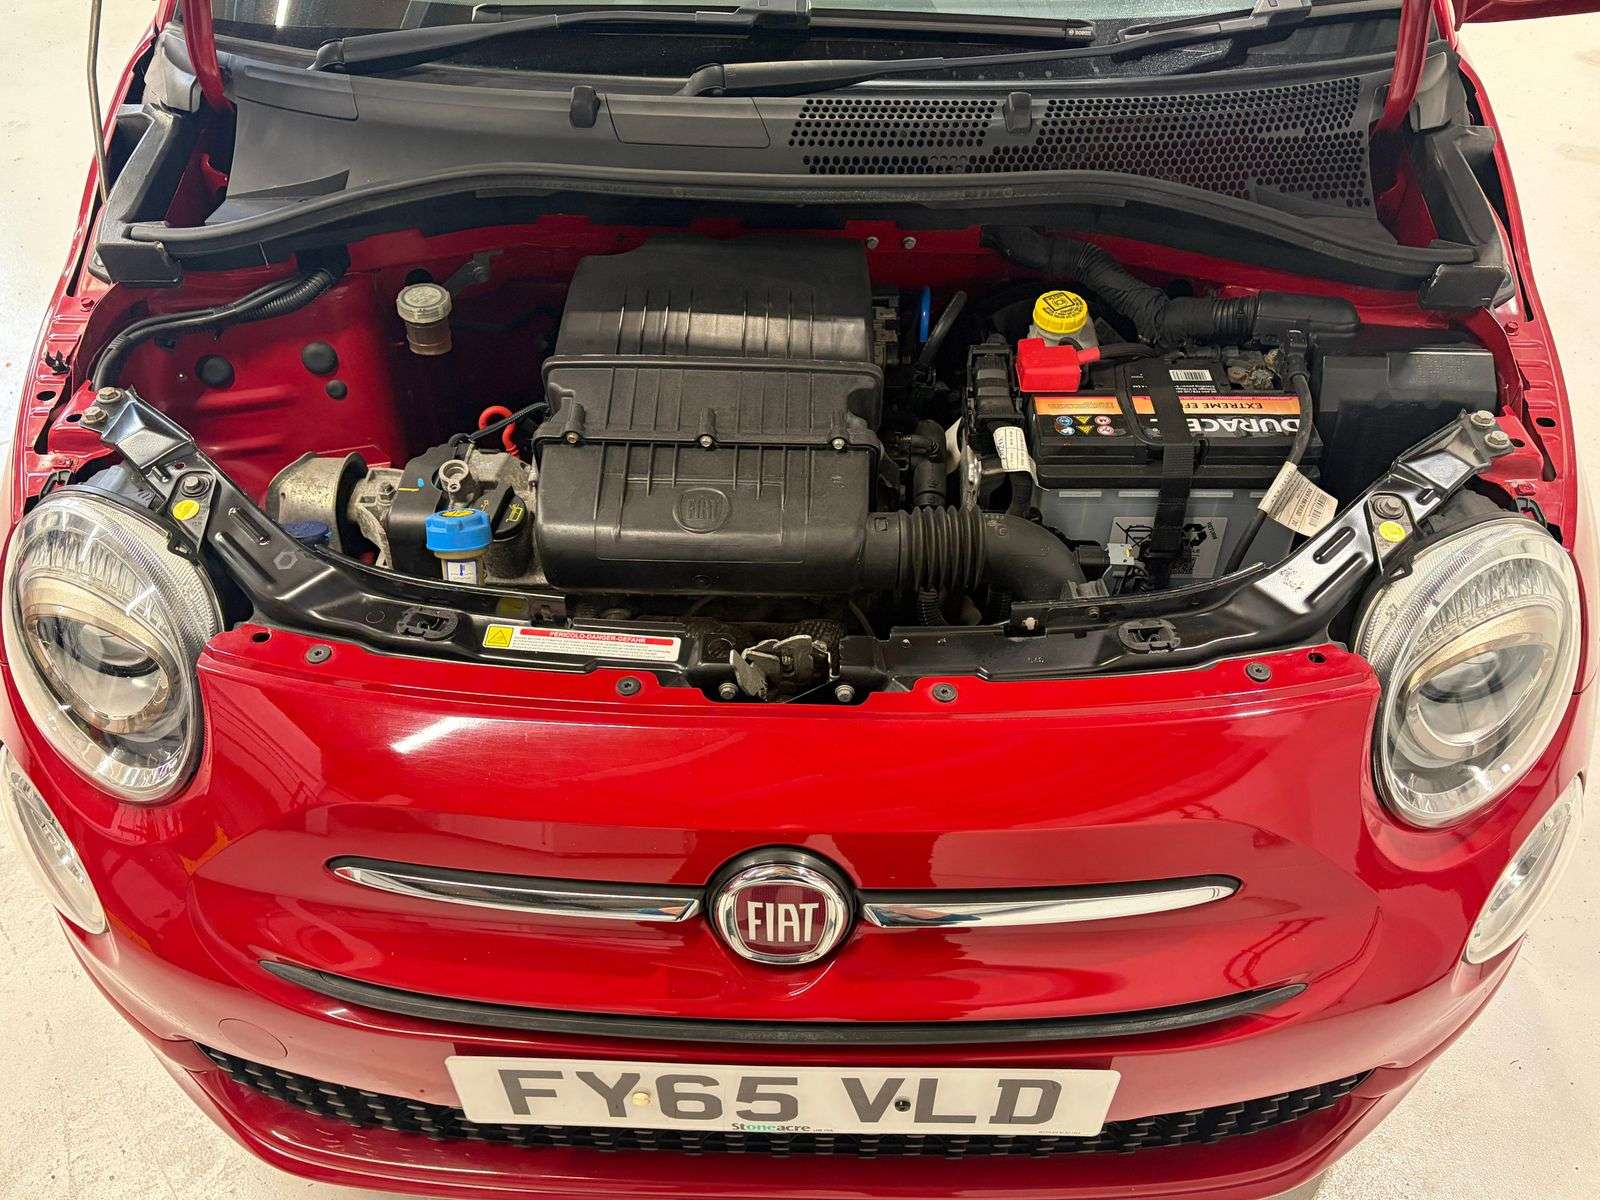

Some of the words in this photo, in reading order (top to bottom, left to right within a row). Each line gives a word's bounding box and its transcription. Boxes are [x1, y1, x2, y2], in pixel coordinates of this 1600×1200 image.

[1201, 402, 1263, 410] EXTREME
[1150, 418, 1300, 432] DURACE
[686, 498, 720, 520] FIAT
[747, 901, 820, 943] FIAT
[497, 1069, 799, 1122] FY65
[841, 1077, 1063, 1125] VLD
[731, 1122, 811, 1132] Stoneacre
